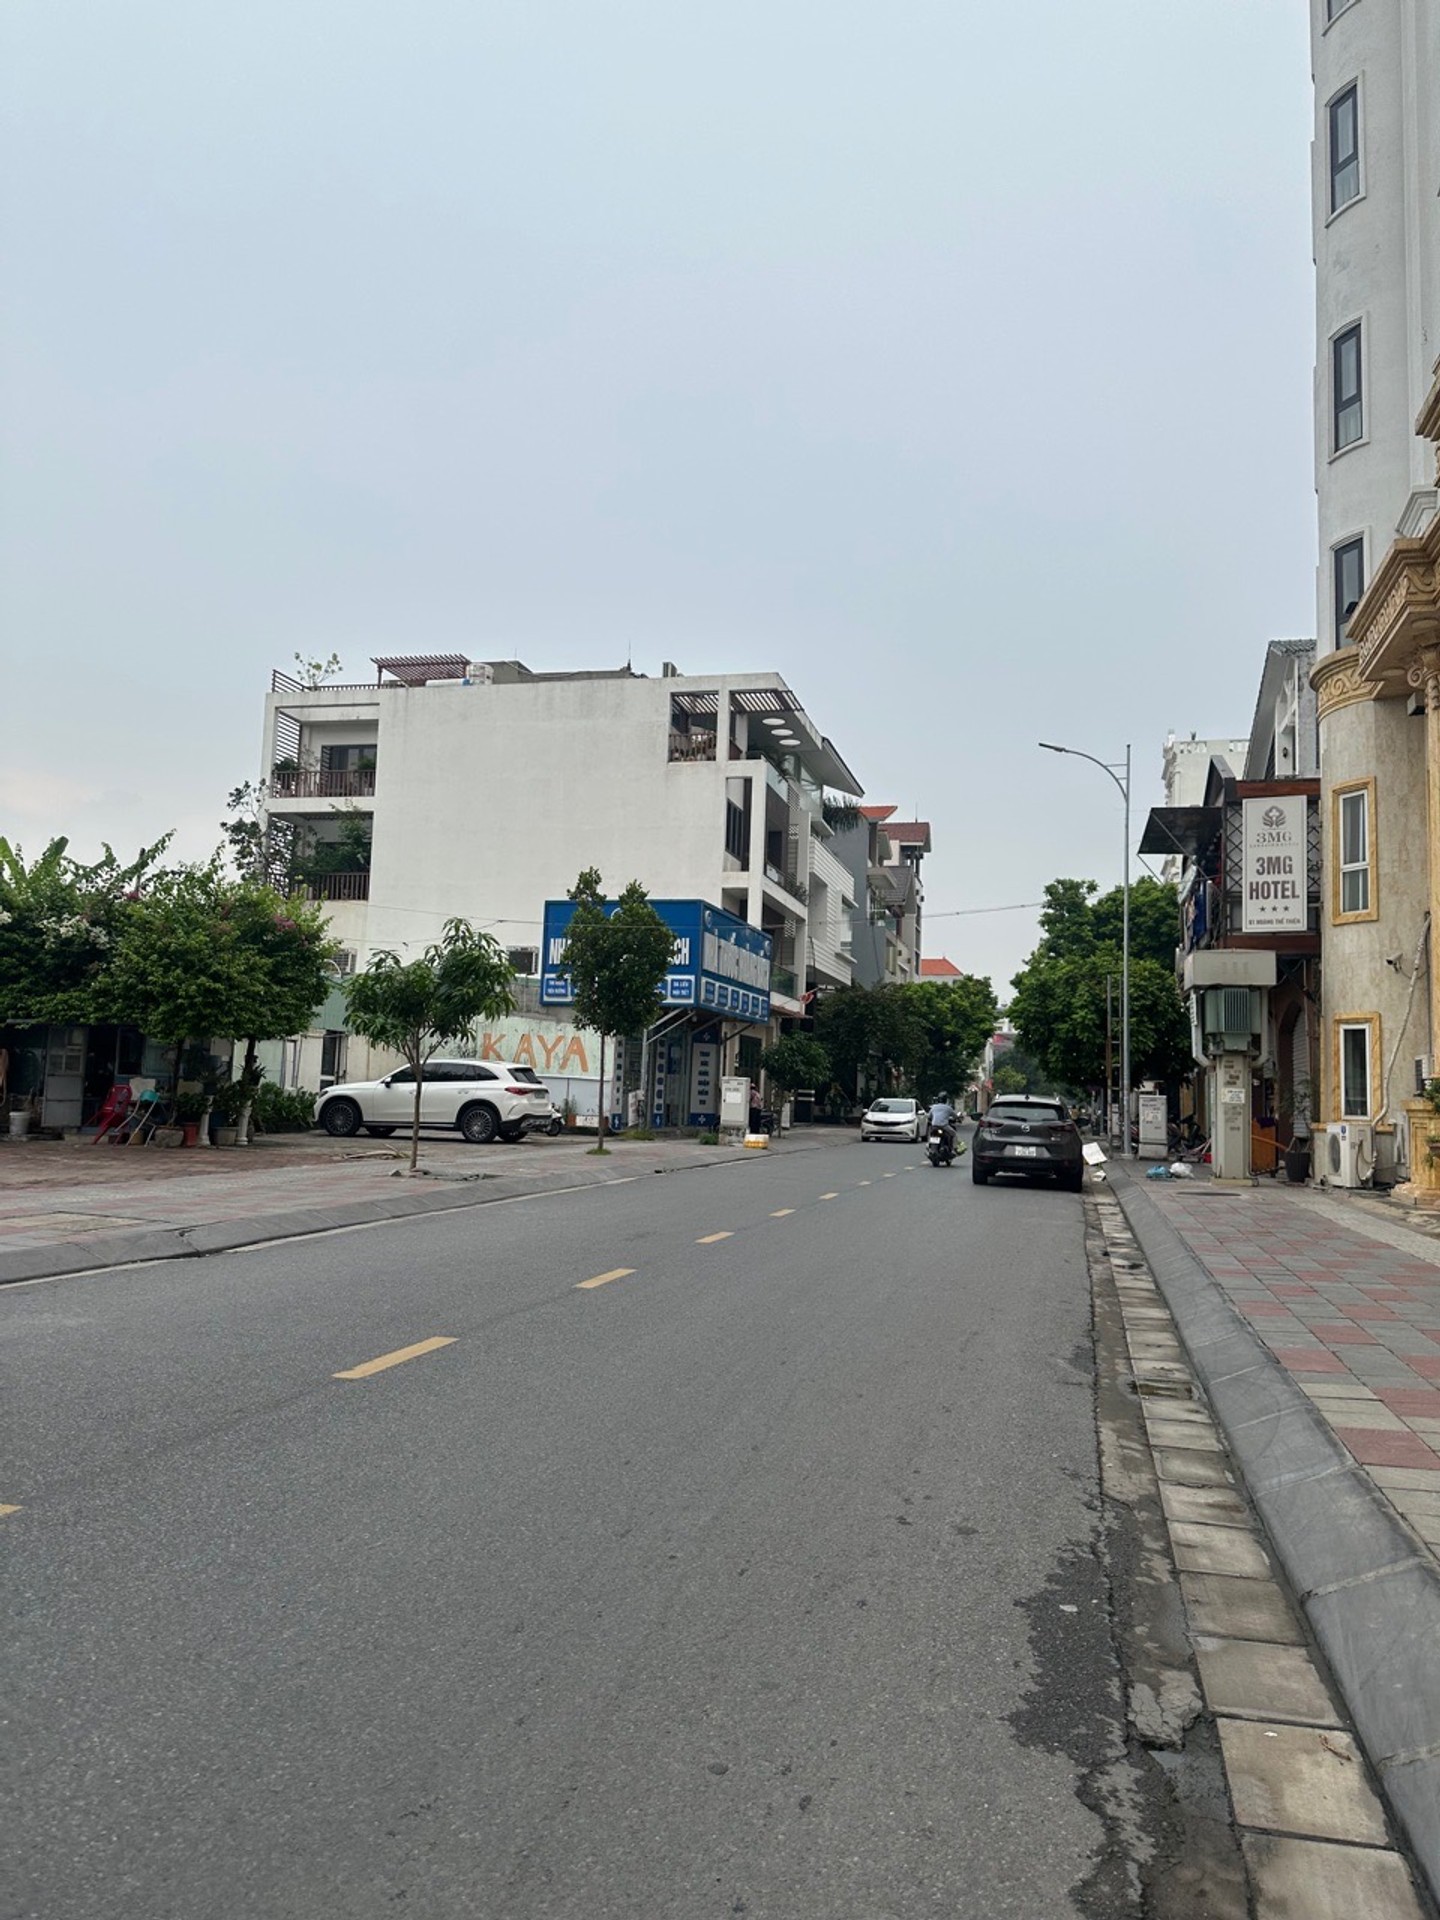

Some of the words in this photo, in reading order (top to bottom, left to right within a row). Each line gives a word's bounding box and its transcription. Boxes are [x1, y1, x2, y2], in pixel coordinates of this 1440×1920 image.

[1256, 831, 1292, 843] 3MG
[1256, 856, 1293, 876] 3MG
[1249, 880, 1300, 900] HOTEL
[481, 1032, 589, 1073] KAYA
